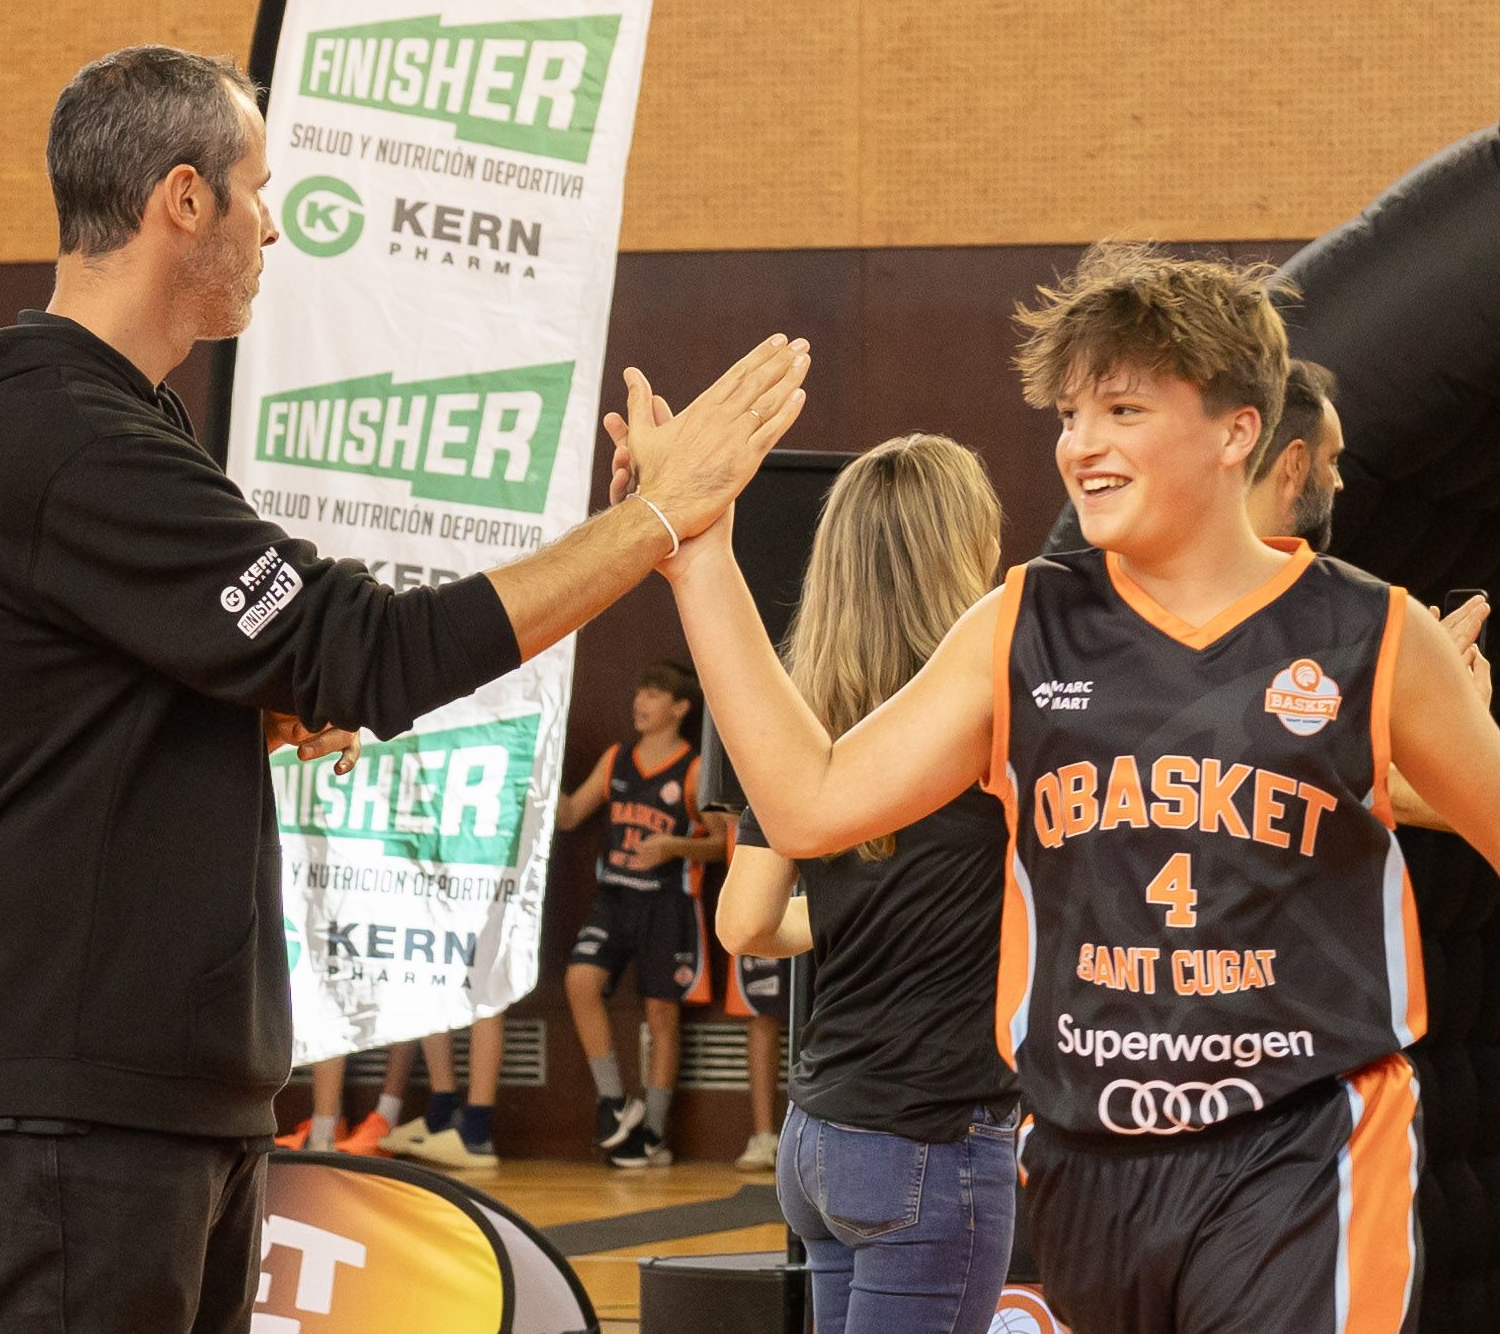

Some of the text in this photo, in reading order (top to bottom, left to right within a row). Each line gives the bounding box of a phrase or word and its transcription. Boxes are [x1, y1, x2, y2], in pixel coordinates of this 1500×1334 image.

[308, 37, 589, 132] FINISHER
[289, 122, 585, 201] SALUD Y NUTRICIÓN DEPORTIVA
[392, 197, 543, 258] KERN
[389, 241, 538, 281] PHARMA
[264, 390, 544, 482] FINISHER
[250, 488, 543, 549] SALUD Y NUTRICIÓN DEPORTIVA
[239, 546, 278, 587] KERN
[240, 570, 296, 632] FINISHER
[1051, 679, 1094, 694] MARC
[271, 745, 510, 837] NISHER
[1033, 754, 1339, 856] QBASKET
[292, 861, 301, 886] Y
[413, 870, 516, 903] DEPORTIVA
[1145, 852, 1198, 928] 4
[327, 920, 478, 967] KERN
[1076, 943, 1276, 996] SANT CUGAT
[327, 964, 472, 991] PHARMA
[1056, 1012, 1315, 1067] Superwagen
